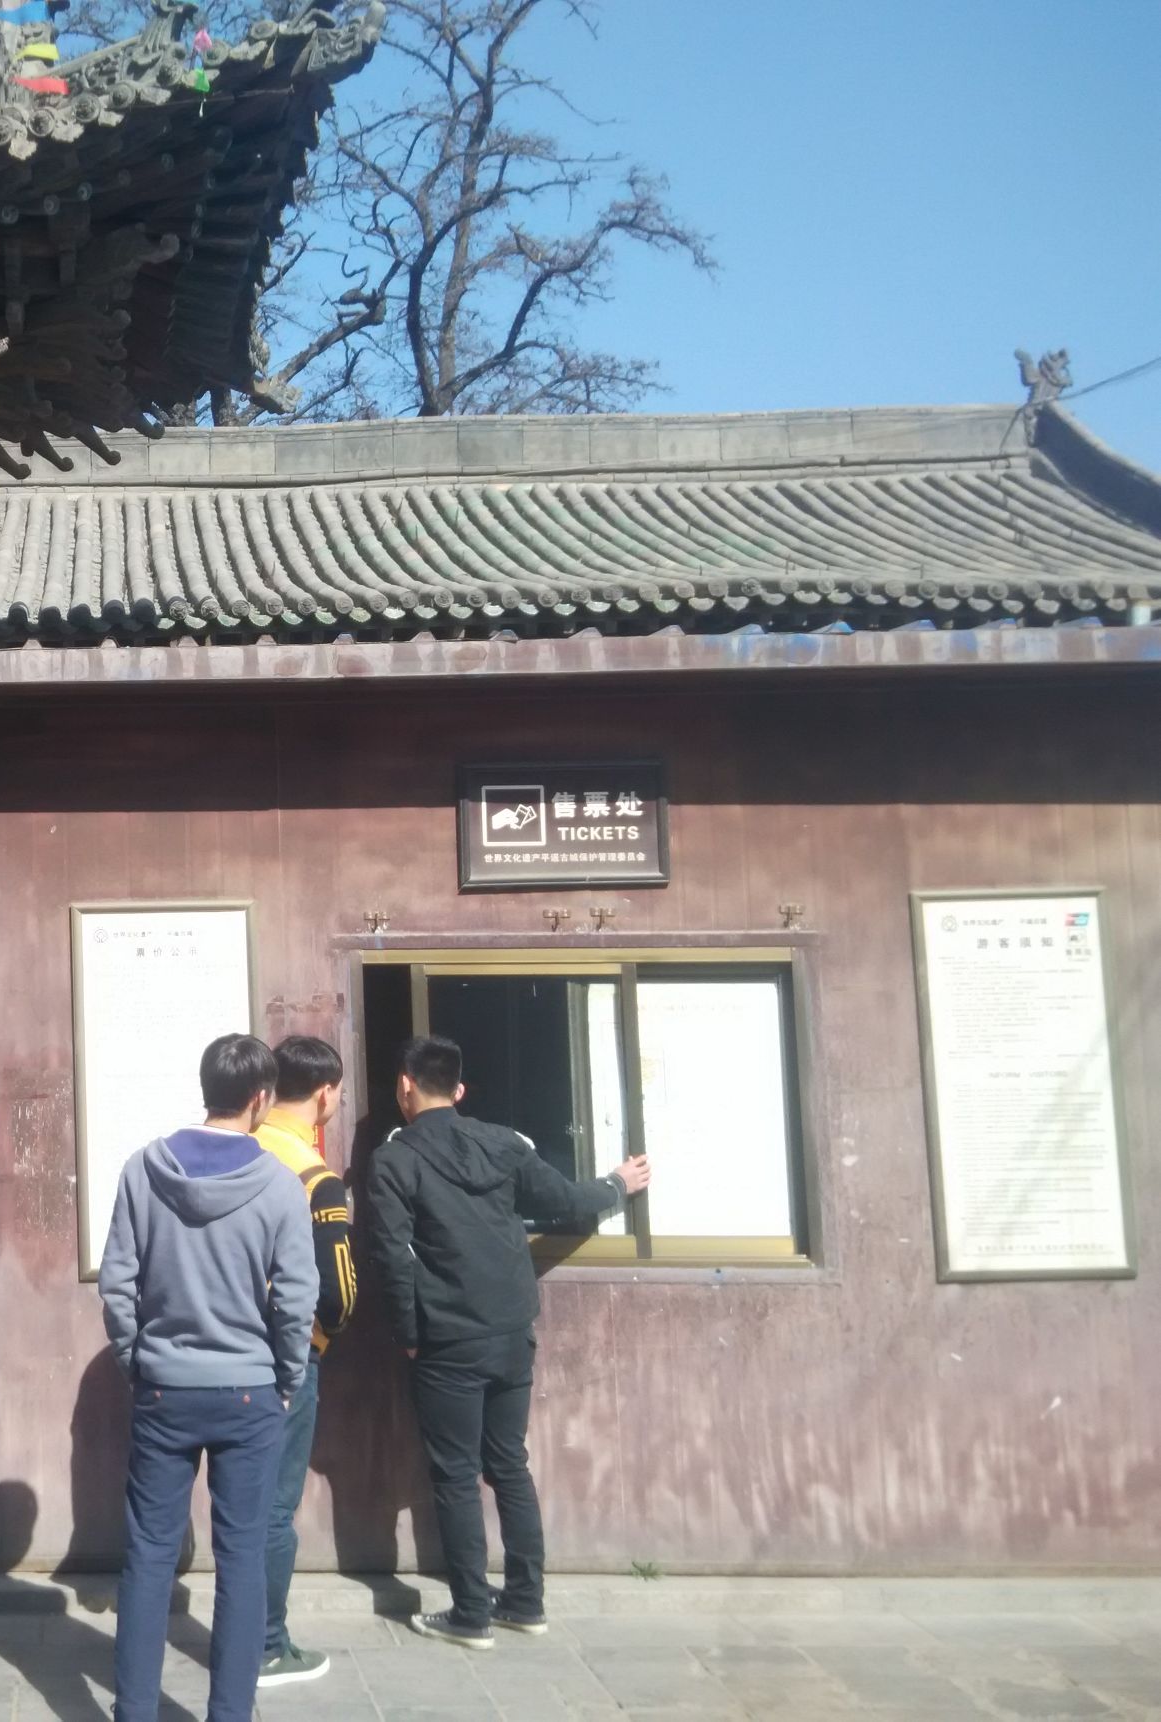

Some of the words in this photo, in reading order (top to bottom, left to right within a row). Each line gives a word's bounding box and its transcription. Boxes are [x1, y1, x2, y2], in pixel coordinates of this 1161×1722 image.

[552, 791, 643, 818] 售票处
[557, 826, 640, 841] TICKETS
